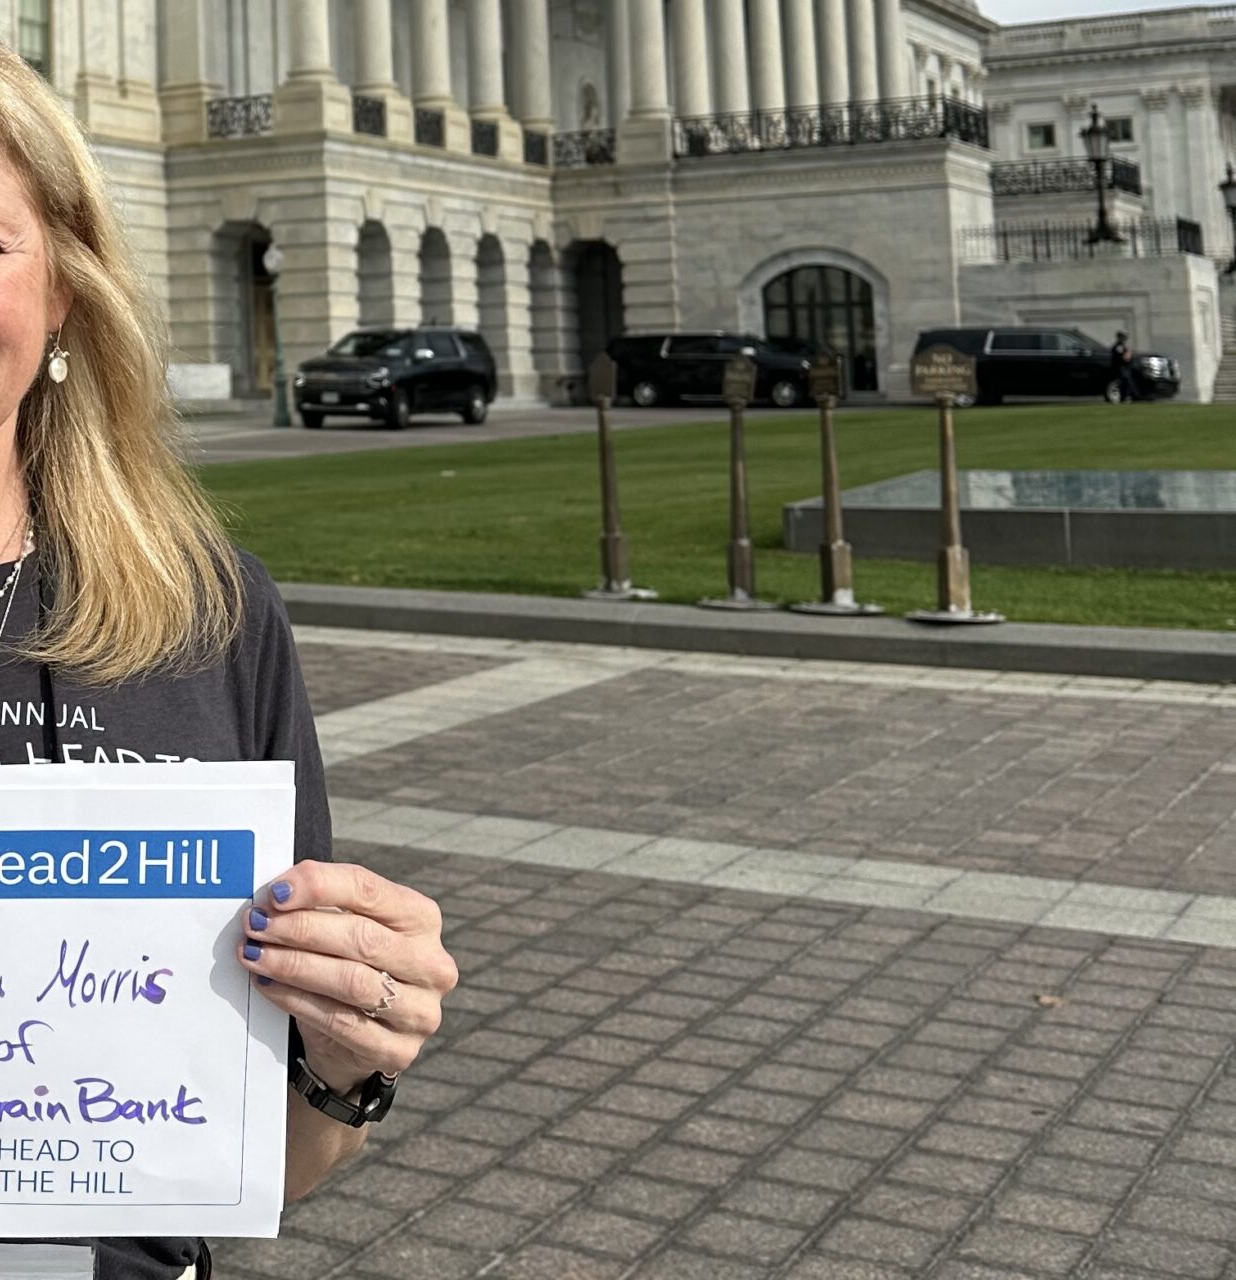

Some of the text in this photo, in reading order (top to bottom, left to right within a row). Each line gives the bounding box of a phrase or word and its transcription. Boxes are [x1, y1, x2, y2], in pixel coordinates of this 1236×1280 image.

[36, 939, 173, 1008] Morris
[92, 1139, 135, 1163] TO
[70, 1171, 133, 1194] HILL
